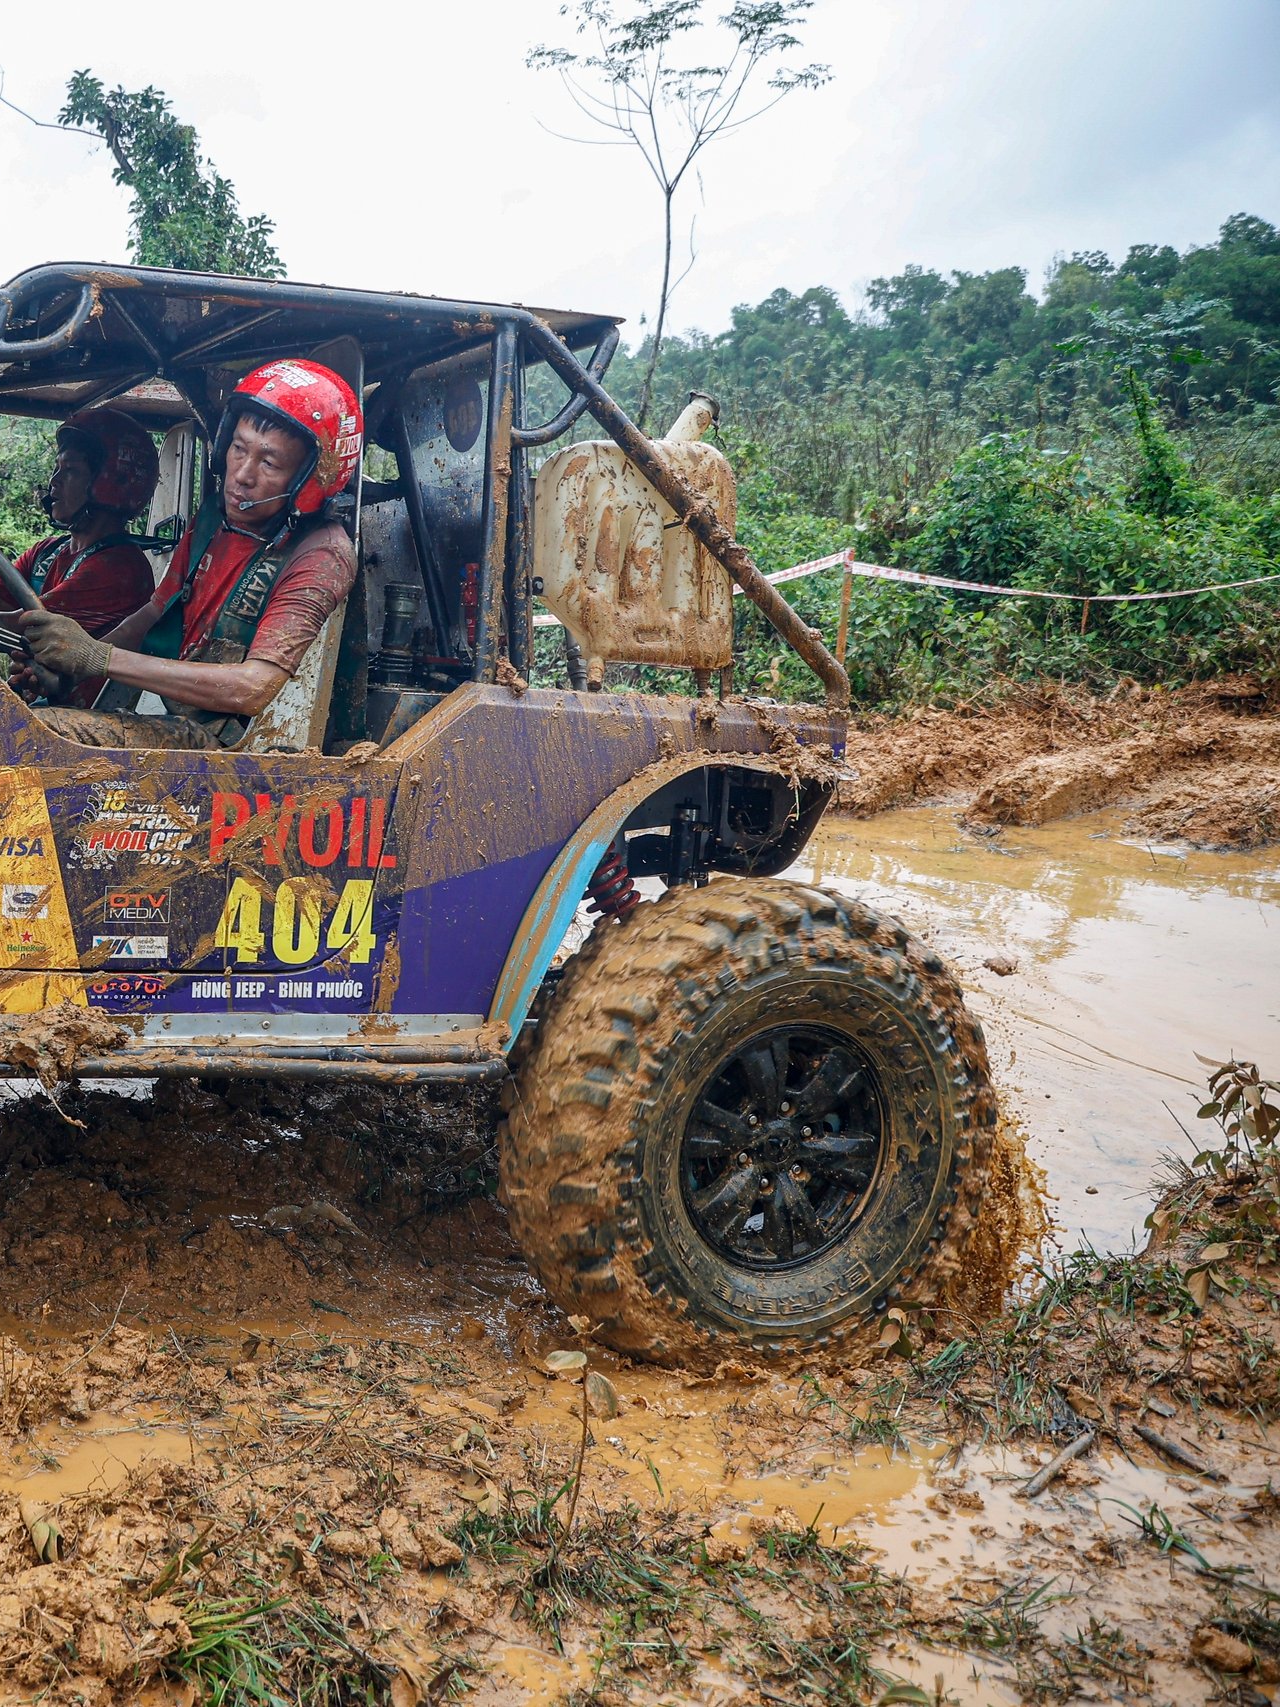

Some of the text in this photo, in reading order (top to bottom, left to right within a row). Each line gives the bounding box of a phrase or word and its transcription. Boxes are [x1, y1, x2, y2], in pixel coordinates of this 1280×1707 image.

[102, 789, 128, 811] 18
[138, 804, 200, 813] VIETAM
[208, 790, 398, 868] PVOIL
[87, 830, 148, 851] PVOIL
[109, 893, 166, 908] OTV
[109, 907, 166, 923] MEDIA
[214, 877, 376, 964] 404
[192, 979, 231, 999] HÙNG
[235, 981, 266, 999] JEEP
[279, 979, 313, 999] BÌNH
[316, 979, 363, 999] PHƯỚC
[710, 1260, 871, 1316] EXTREME
